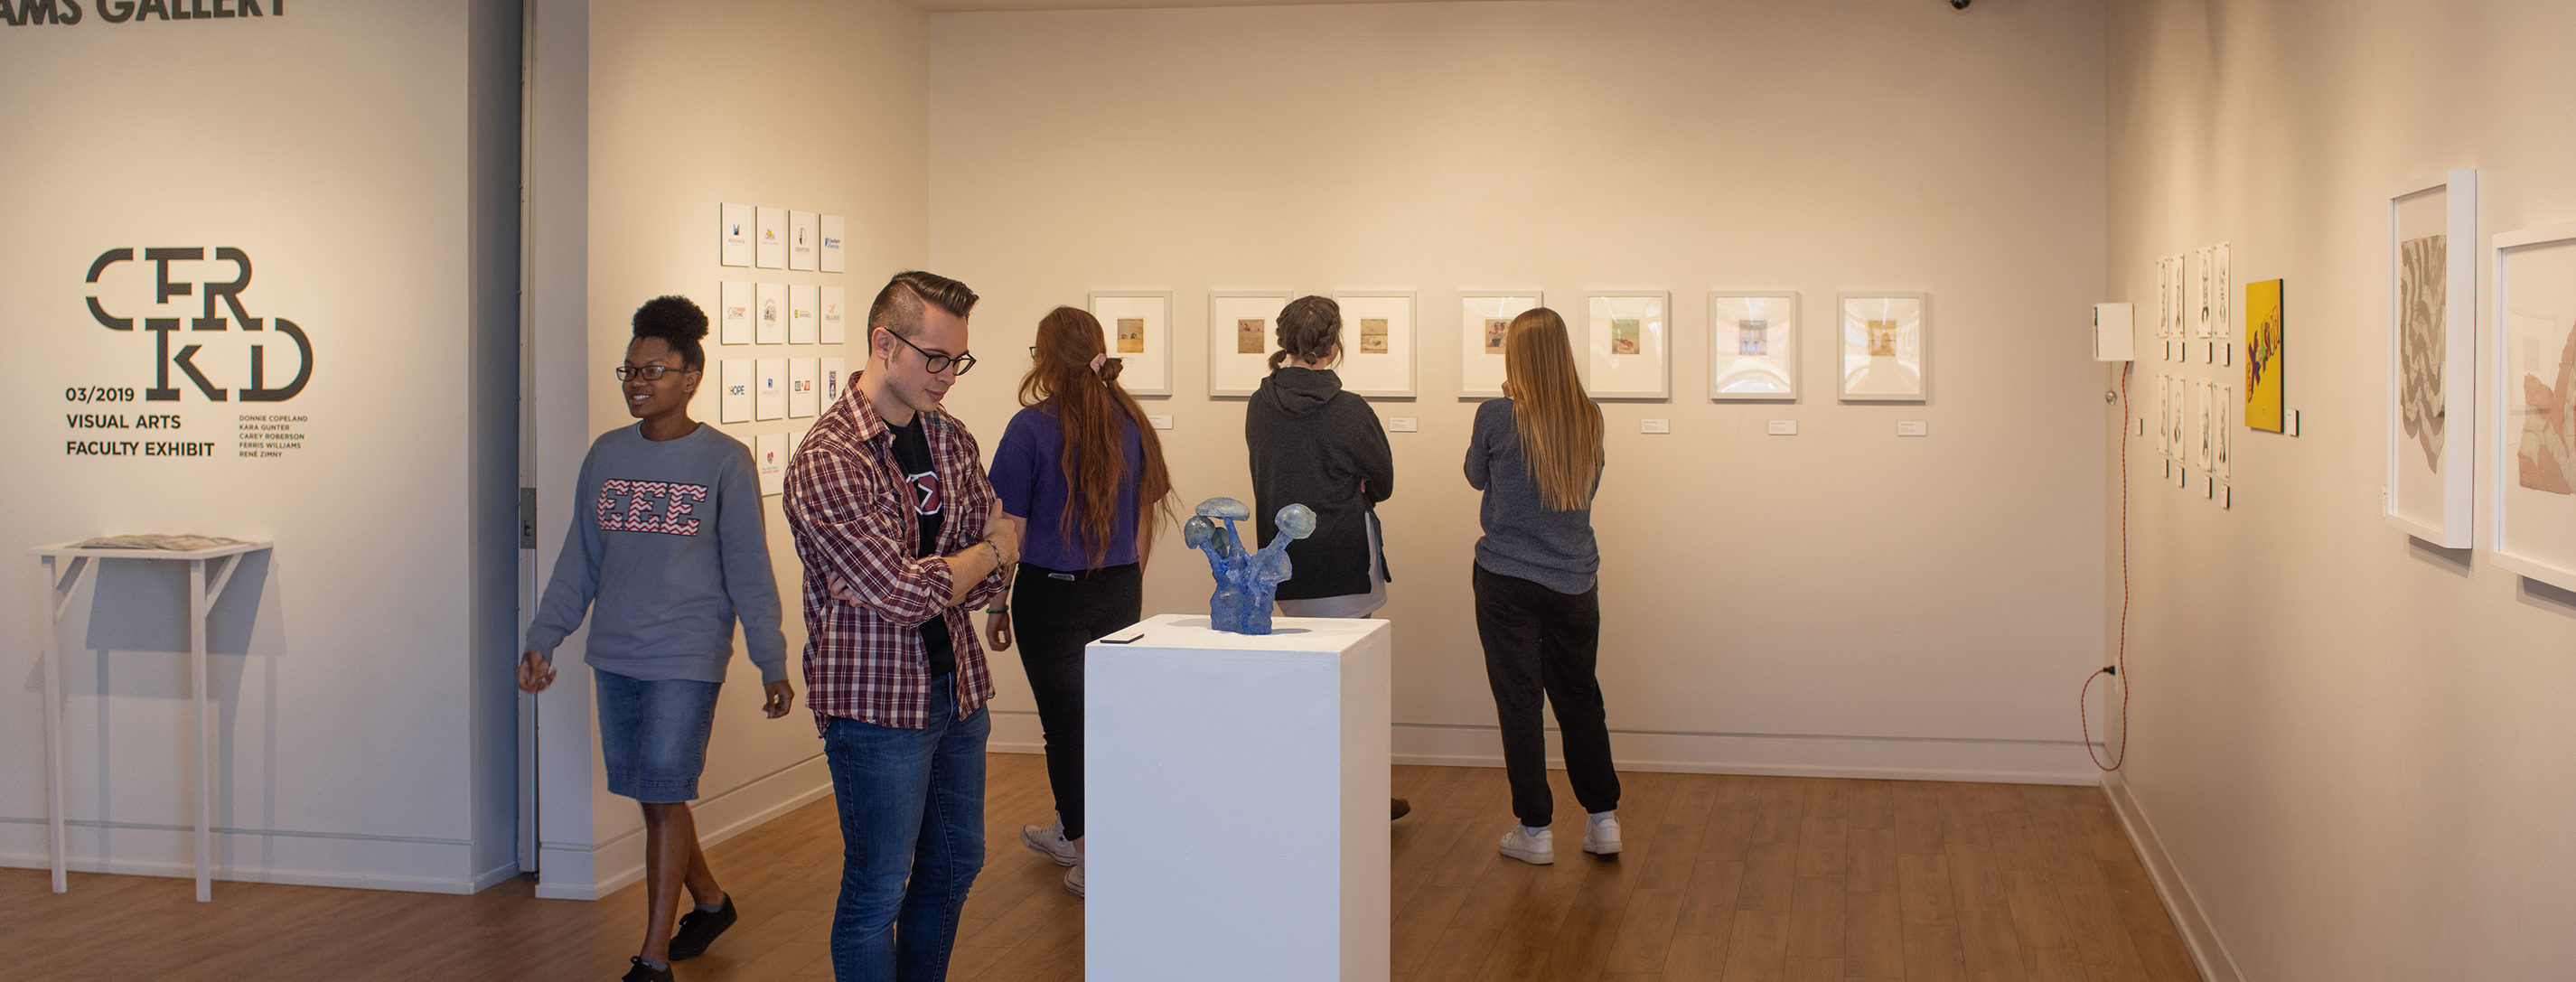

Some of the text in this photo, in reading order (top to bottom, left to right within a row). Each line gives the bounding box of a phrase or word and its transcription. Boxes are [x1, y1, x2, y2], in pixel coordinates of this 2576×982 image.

[65, 386, 135, 405] 03/2019
[66, 414, 182, 430] VISUAL ARTS
[269, 415, 309, 423] COPELAND
[66, 441, 215, 457] FACULTY EXHIBIT
